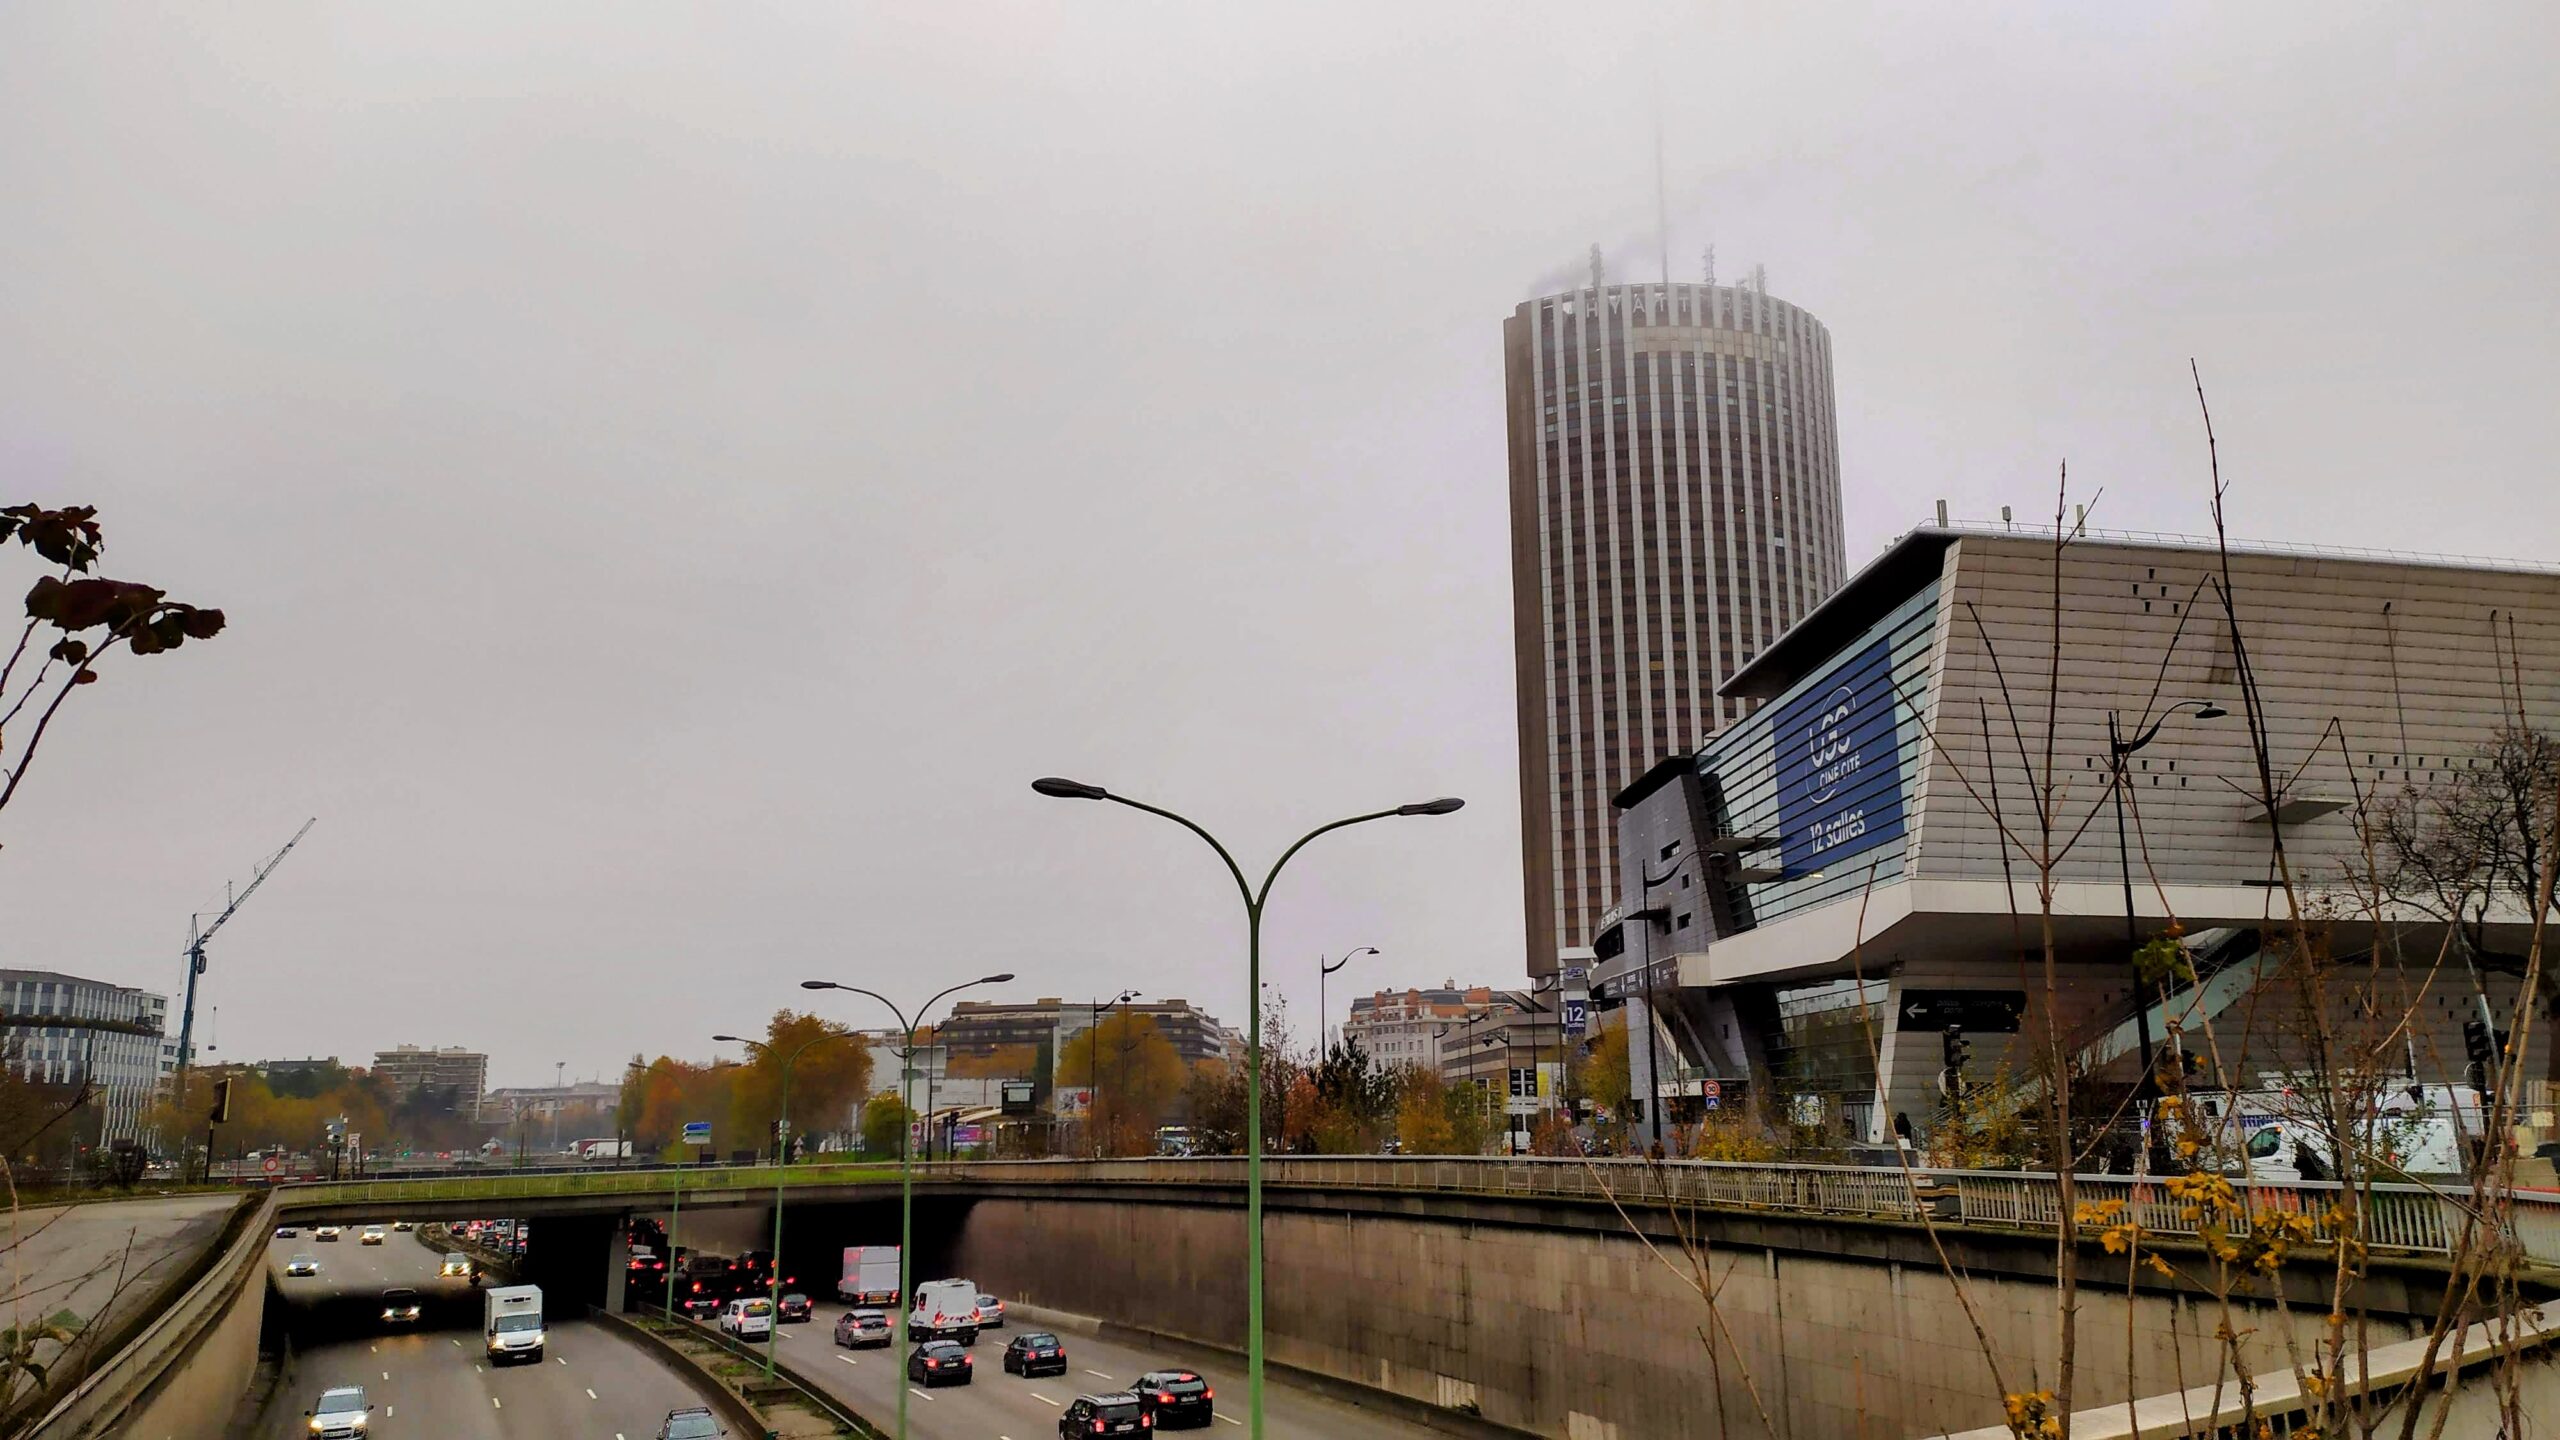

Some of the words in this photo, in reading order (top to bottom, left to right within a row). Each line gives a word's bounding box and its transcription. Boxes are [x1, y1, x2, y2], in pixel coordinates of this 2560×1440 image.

[1586, 294, 1688, 317] HYATT
[1724, 300, 1811, 341] REGEC
[1809, 705, 1851, 768] UGC
[1819, 763, 1840, 791] CINÉ
[1841, 752, 1862, 779] CITÉ
[1809, 823, 1824, 854] 12
[1826, 808, 1865, 848] salles
[1567, 1006, 1585, 1022] 12
